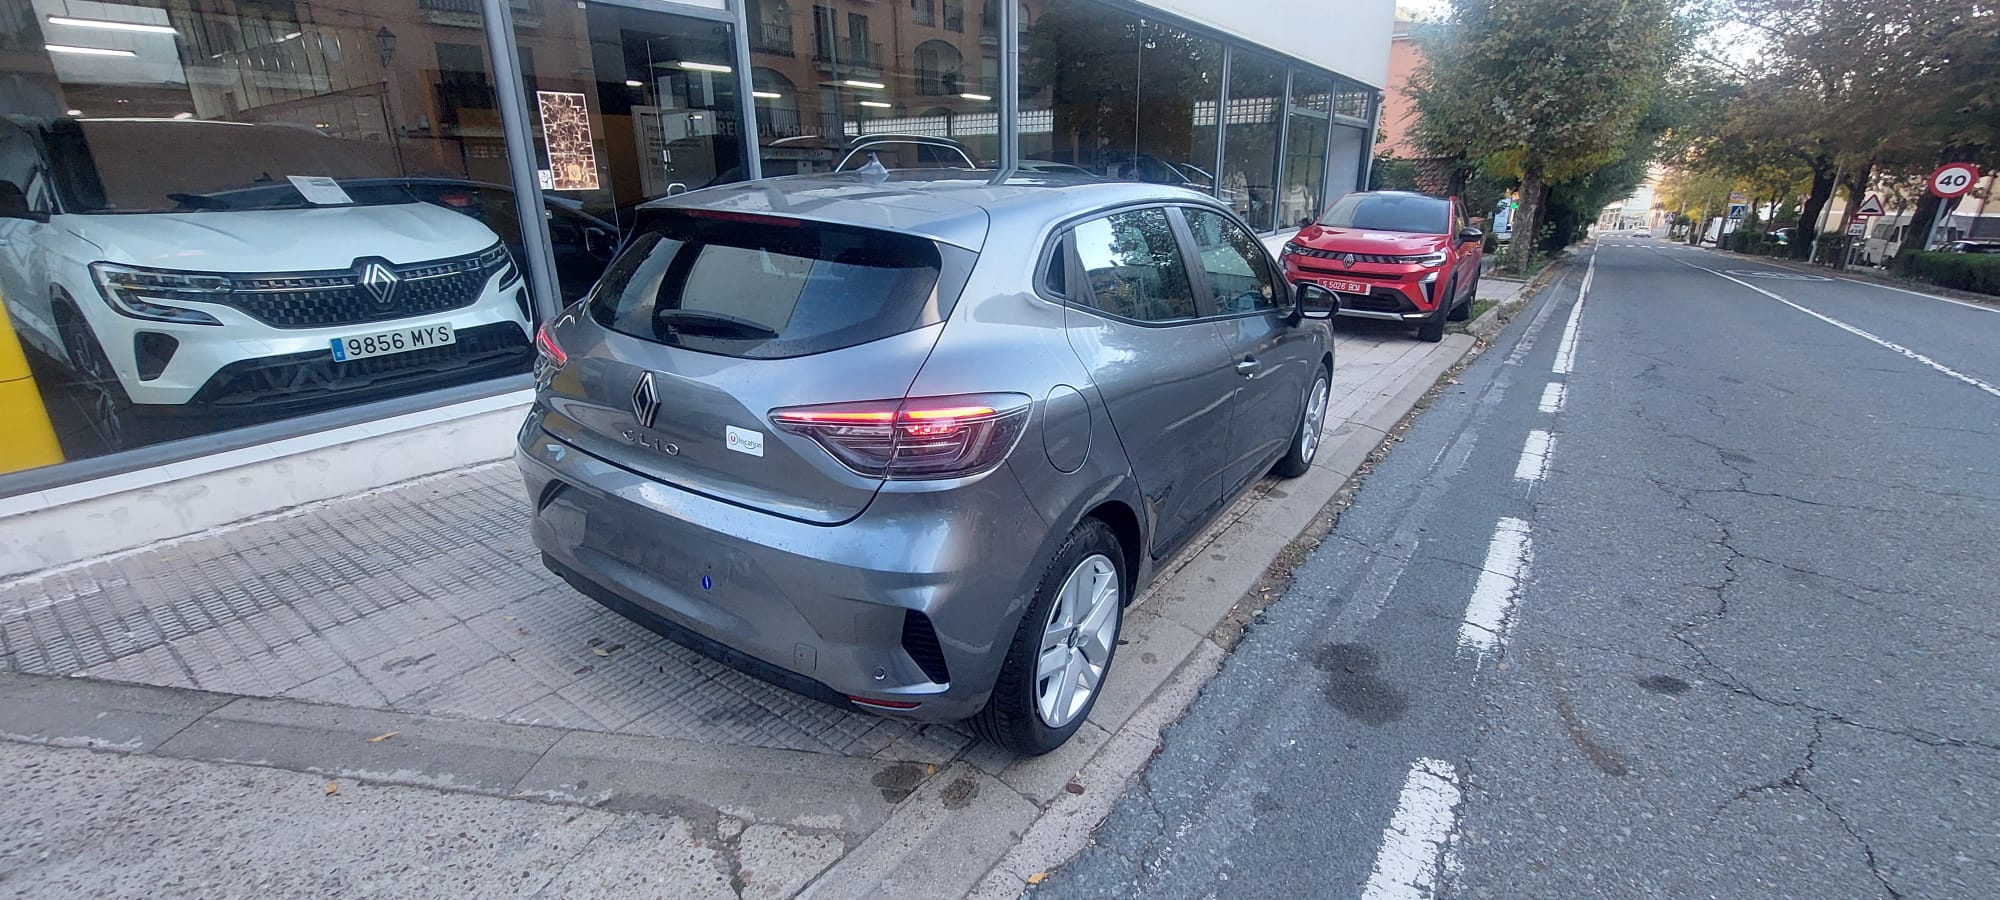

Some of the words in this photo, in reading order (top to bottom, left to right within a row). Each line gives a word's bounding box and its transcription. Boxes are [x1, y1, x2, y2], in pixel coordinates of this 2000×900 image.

[1939, 175, 1967, 186] 40
[348, 332, 404, 355] 9856
[411, 326, 450, 346] MYS
[622, 429, 680, 456] CLIO
[738, 437, 763, 448] location
